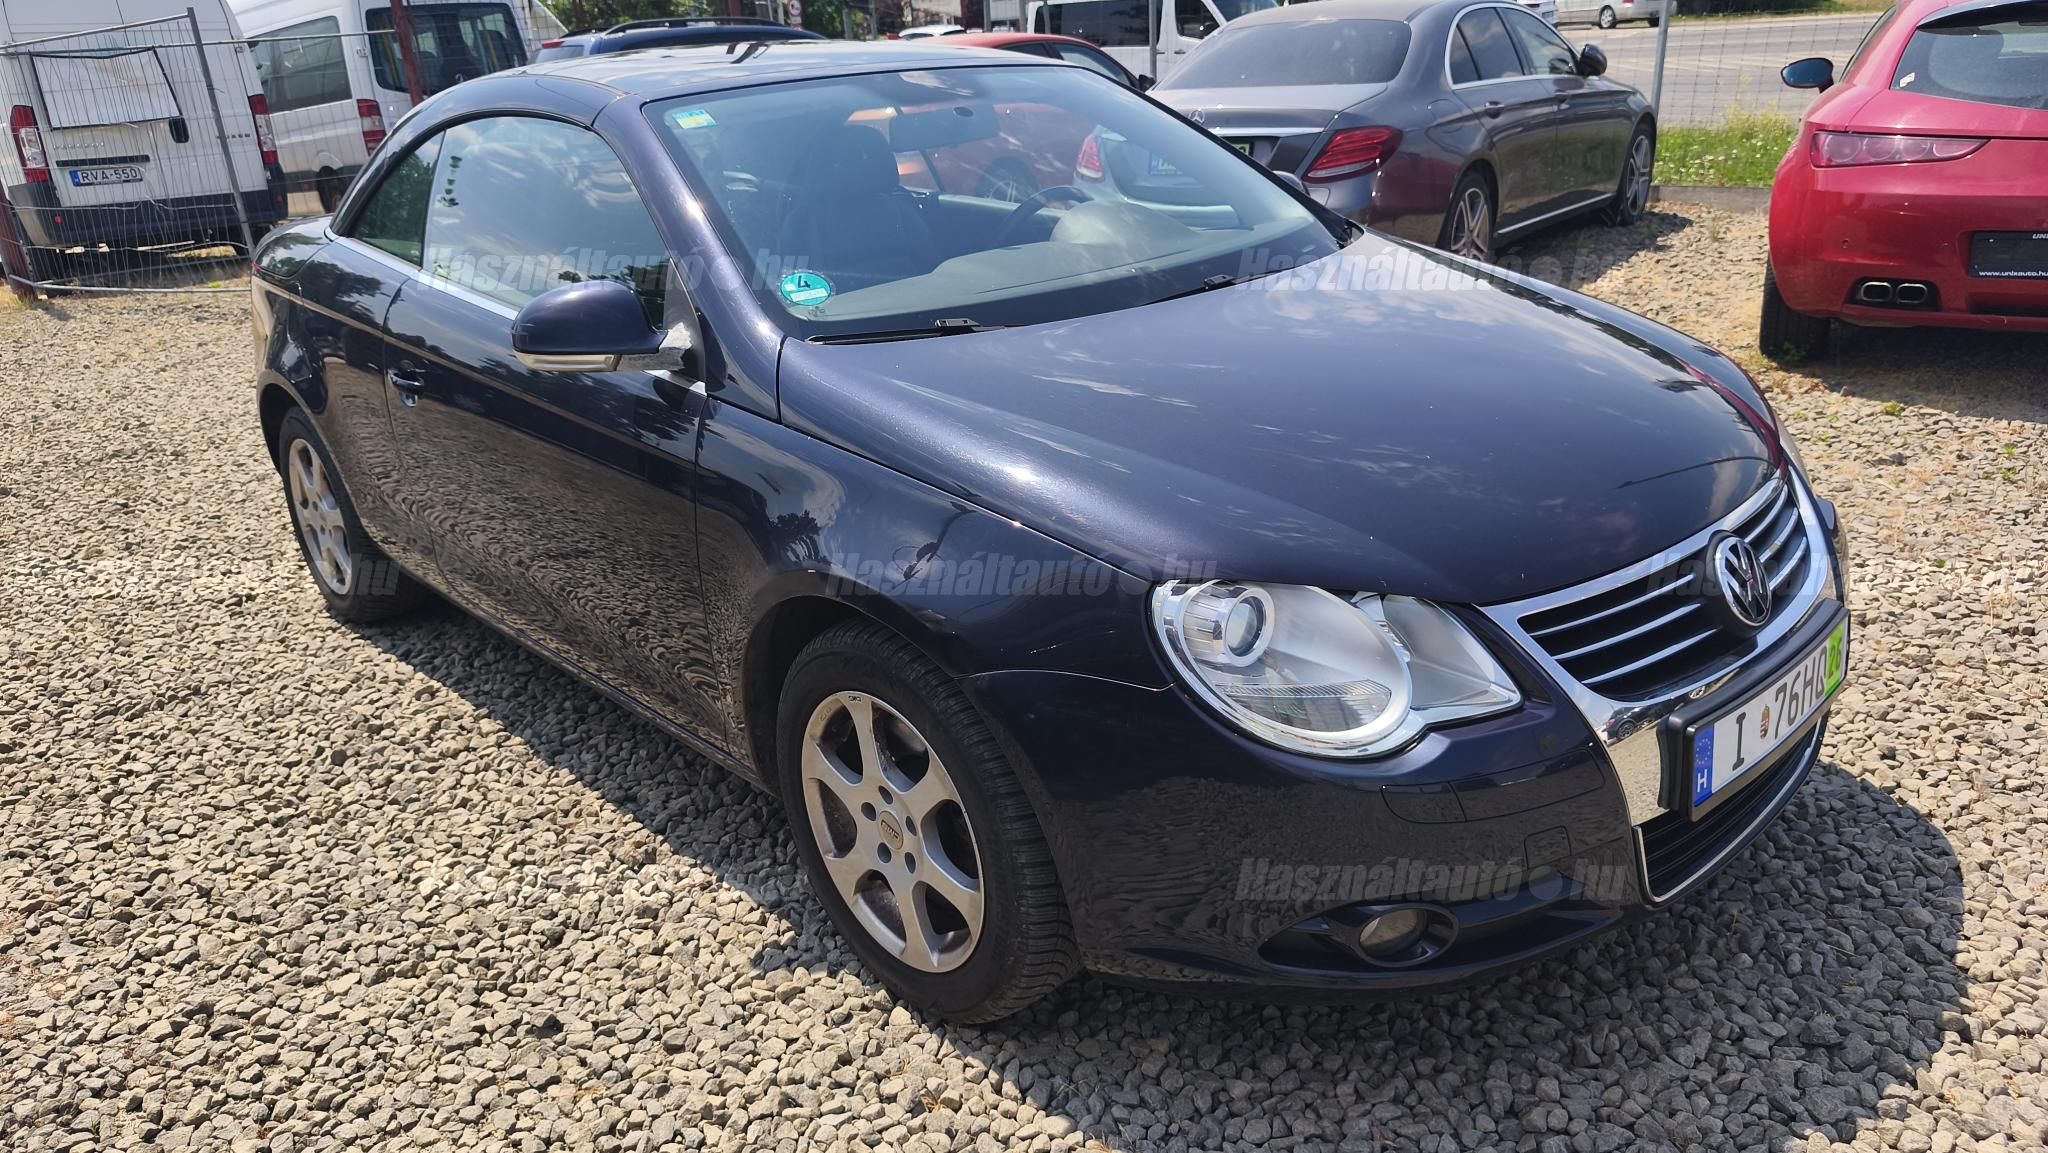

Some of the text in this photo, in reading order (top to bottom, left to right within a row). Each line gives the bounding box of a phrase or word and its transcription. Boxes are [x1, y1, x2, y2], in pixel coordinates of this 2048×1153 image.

[81, 168, 138, 183] RVA-550
[1979, 269, 2048, 277] www.unixauto.hu
[797, 275, 811, 288] 4
[1697, 769, 1708, 793] H
[1732, 711, 1747, 771] I
